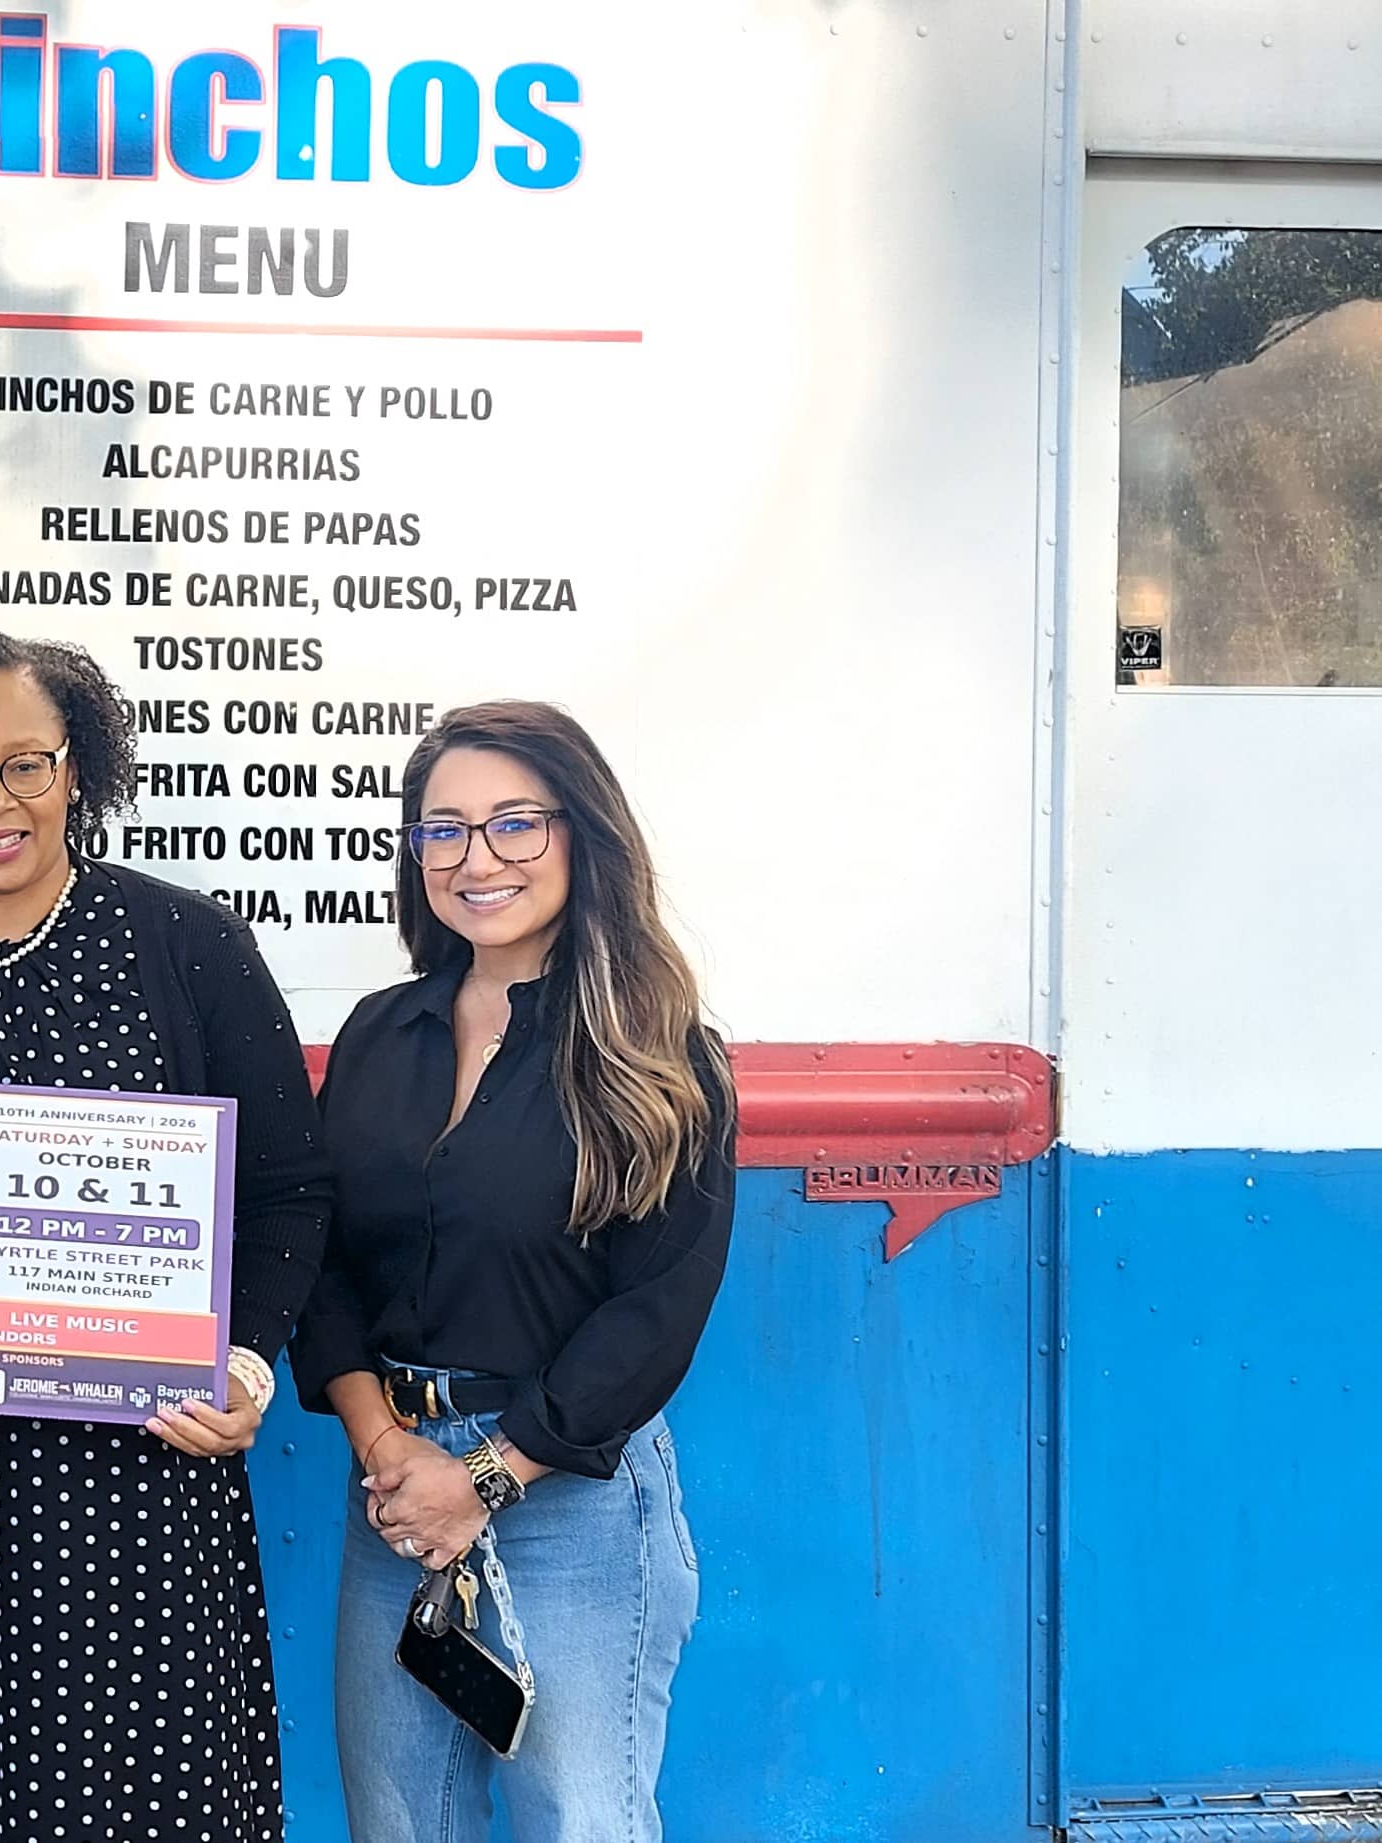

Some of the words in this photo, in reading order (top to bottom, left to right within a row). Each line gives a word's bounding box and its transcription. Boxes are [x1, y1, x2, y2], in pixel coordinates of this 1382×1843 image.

[125, 221, 350, 298] MENU
[148, 380, 195, 415] DE
[209, 382, 331, 417] CARNE
[344, 385, 366, 418] Y
[379, 385, 493, 421] POLLO
[102, 443, 361, 482] ALCAPURRIAS
[40, 507, 229, 544] RELLENOS
[244, 511, 290, 544] DE
[304, 511, 421, 547] PAPAS
[125, 572, 173, 606] DE
[186, 573, 319, 616] CARNE,
[333, 575, 462, 618] QUESO,
[475, 577, 578, 612] PIZZA
[133, 636, 324, 672] TOSTONES
[224, 700, 298, 736] CON
[312, 701, 434, 737] CARNE
[132, 763, 230, 798] FRITA
[243, 763, 318, 799] CON
[122, 826, 227, 861] FRITO
[239, 826, 314, 861] CON
[40, 1109, 147, 1126] ANNIVERSARY
[159, 1117, 197, 1129] 2026
[122, 1137, 209, 1154] SUNDAY
[38, 1151, 152, 1172] OCTOBER
[7, 1173, 61, 1200] 10
[77, 1178, 110, 1204] &
[130, 1181, 182, 1208] 11
[806, 1165, 1002, 1192] GRUMMAN
[41, 1219, 86, 1239] PM
[115, 1223, 133, 1242] 7
[142, 1226, 188, 1246] PM
[65, 1249, 143, 1267] STREET
[149, 1255, 206, 1272] PARK
[8, 1265, 41, 1278] 117
[47, 1268, 96, 1282] MAIN
[102, 1272, 174, 1287] STREET
[25, 1281, 77, 1294] INDIAN
[81, 1285, 153, 1300] ORCHARD
[9, 1311, 59, 1329] LIVE
[66, 1315, 140, 1335] MUSIC
[1, 1352, 65, 1368] SPONSORS
[9, 1378, 59, 1395] JEROMIE
[72, 1382, 123, 1401] WHALEN
[157, 1384, 214, 1401] Baystate
